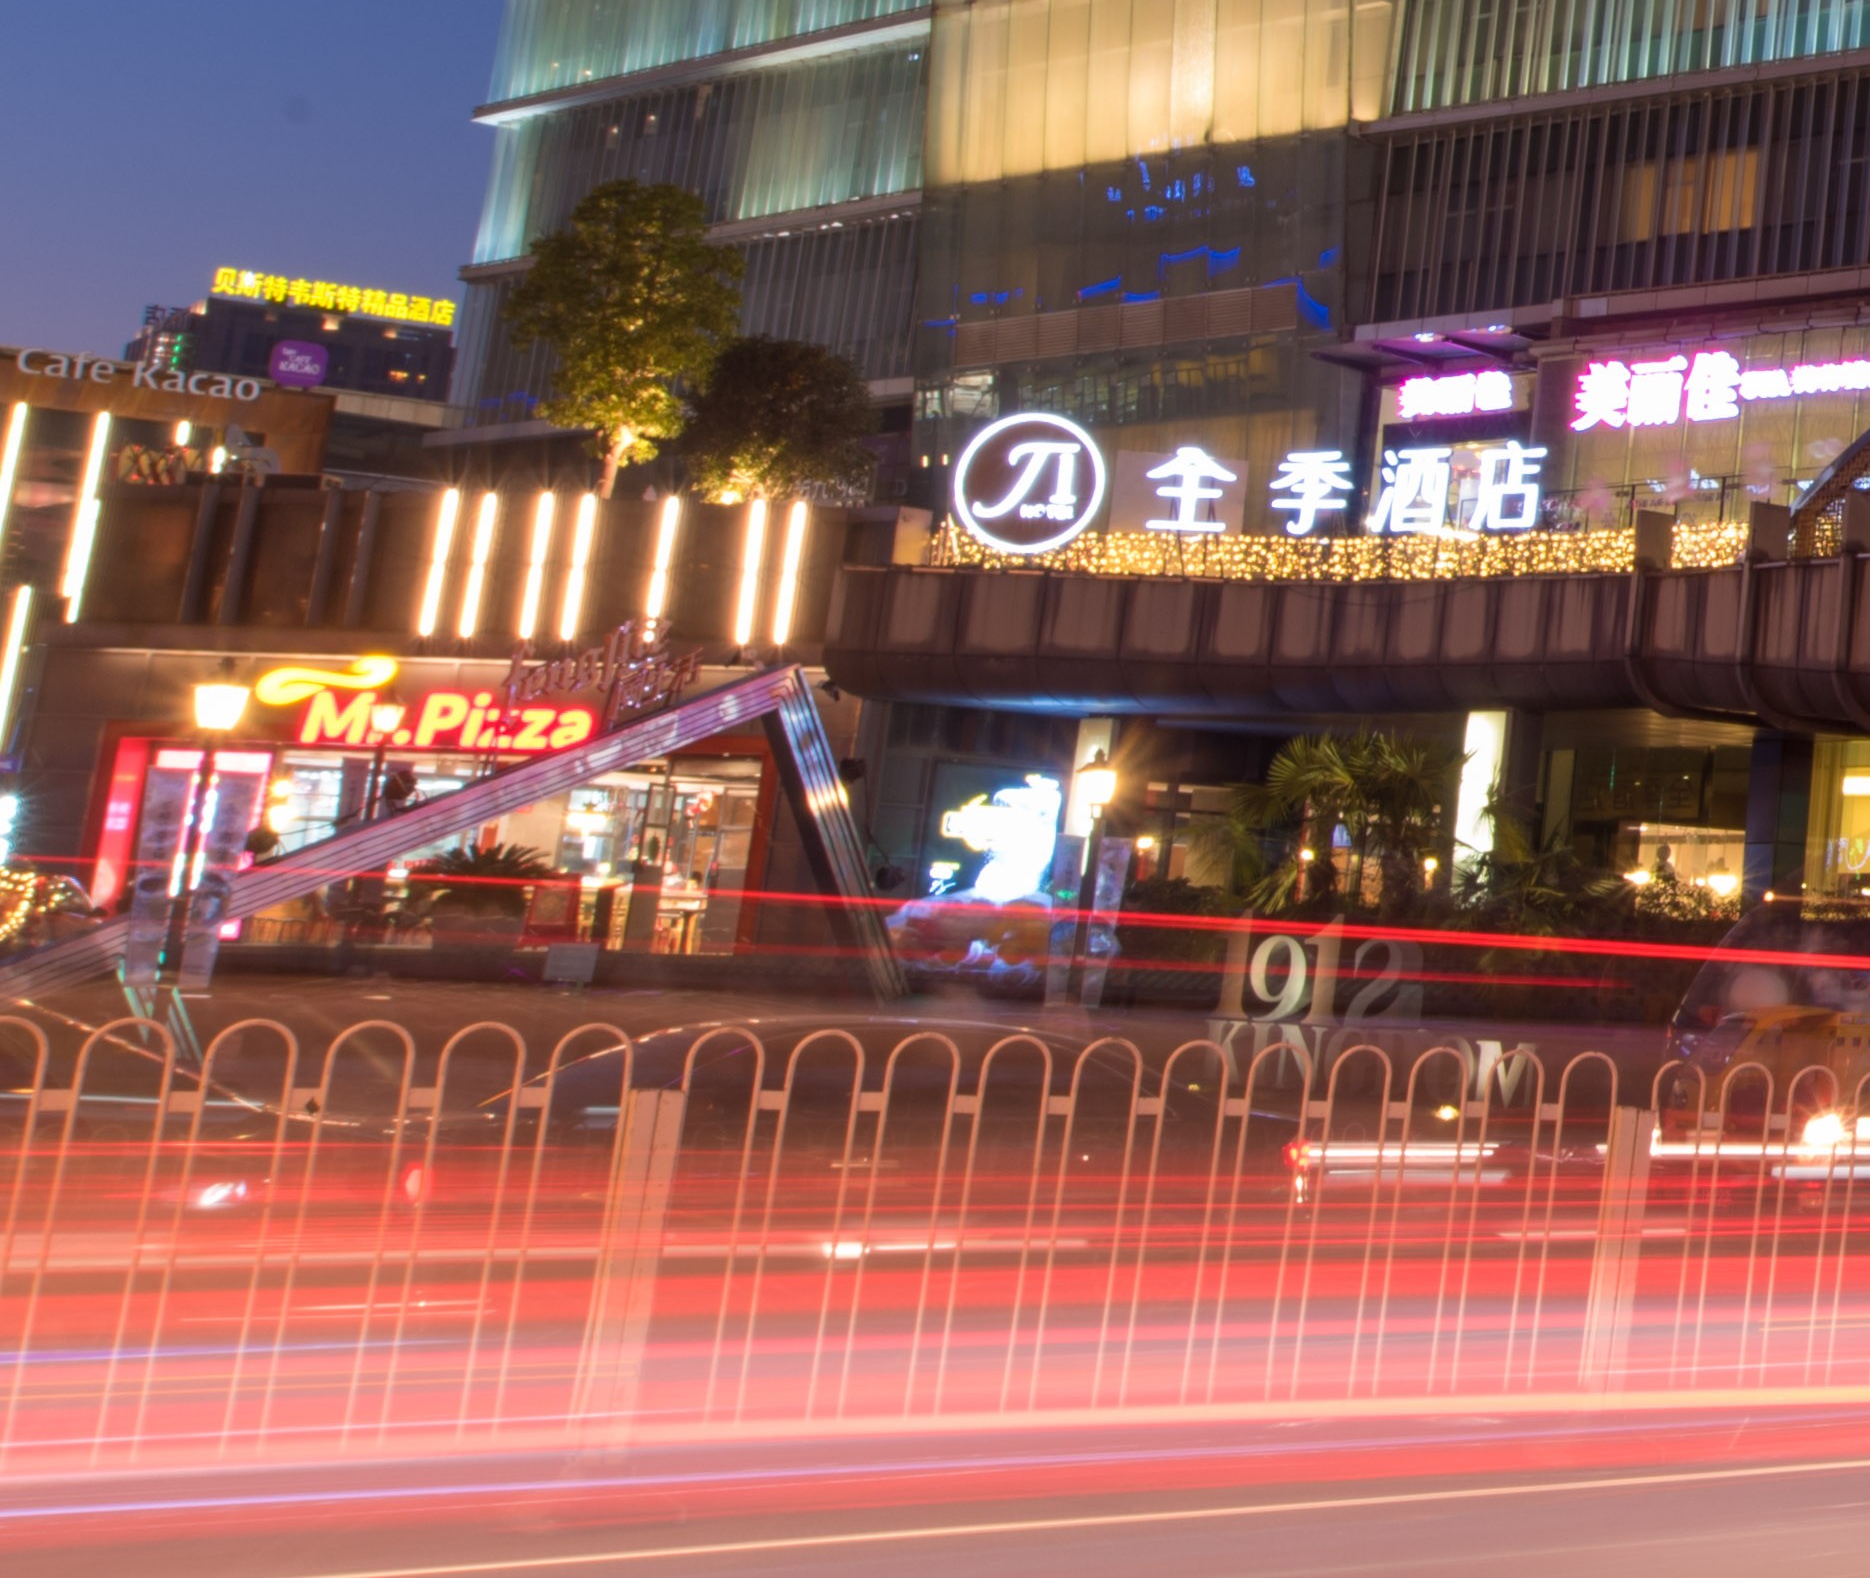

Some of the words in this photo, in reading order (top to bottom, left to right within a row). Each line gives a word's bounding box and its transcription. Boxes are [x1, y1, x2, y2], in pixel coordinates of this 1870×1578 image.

[212, 266, 456, 327] 贝斯特韦斯特精品酒店
[17, 348, 116, 385] Cafe
[132, 362, 261, 402] Kacao
[1145, 440, 1548, 536] 全季酒店
